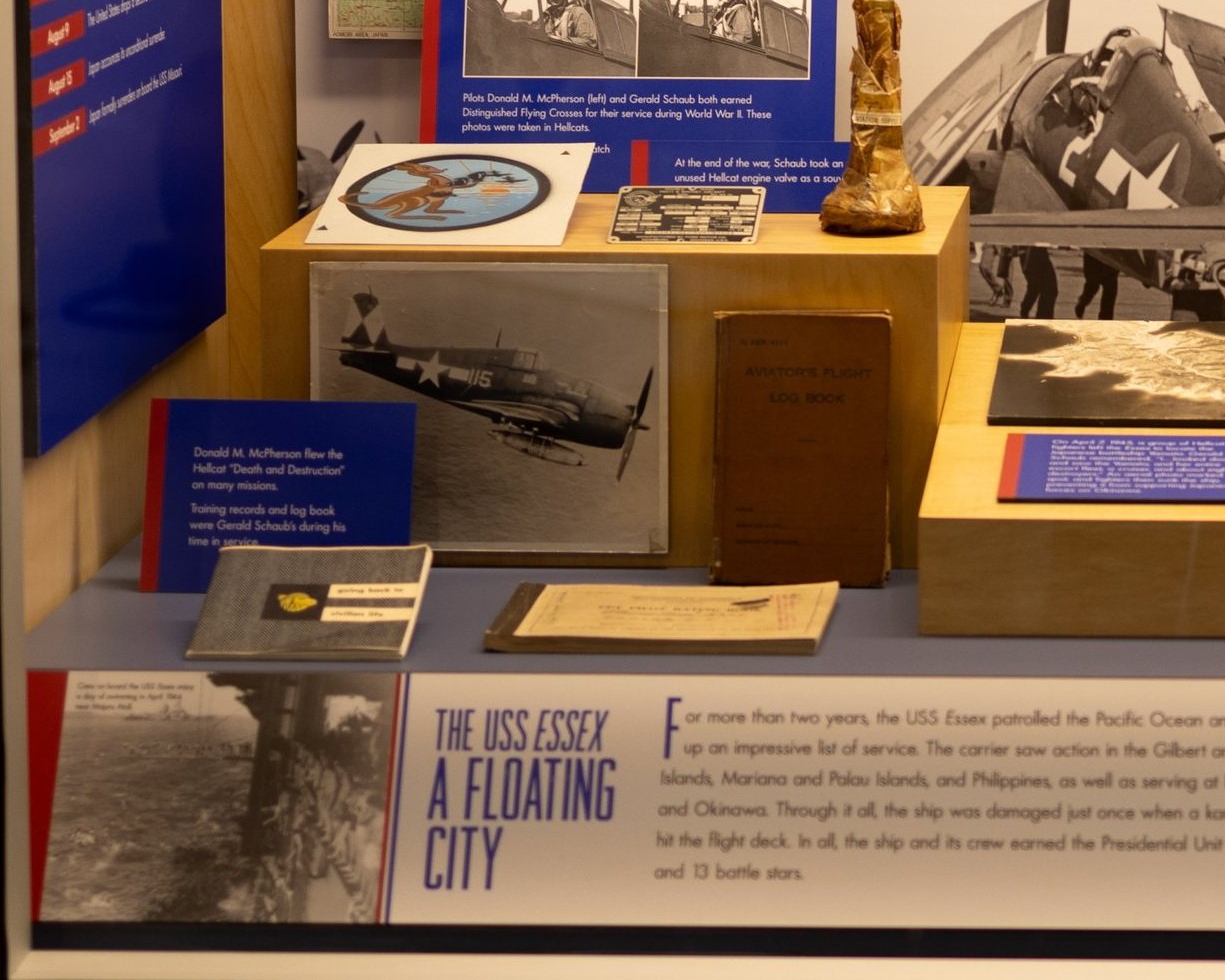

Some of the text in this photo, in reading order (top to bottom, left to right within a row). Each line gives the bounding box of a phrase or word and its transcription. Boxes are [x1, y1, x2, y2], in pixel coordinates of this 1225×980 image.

[462, 92, 752, 104] Pilots Donald M. McPherson (left) and Gerald Schaub both earned
[462, 107, 518, 119] Distinguished
[520, 107, 546, 120] Flying
[548, 107, 583, 118] Crosses
[585, 107, 597, 118] for
[600, 107, 619, 118] their
[621, 109, 652, 118] service
[654, 108, 682, 121] during
[684, 108, 712, 118] World
[714, 109, 734, 118] War
[746, 109, 771, 119] These
[461, 121, 590, 133] photos were taken in Hellcats.
[593, 143, 611, 154] atch
[674, 157, 685, 167] At
[687, 157, 701, 167] the
[703, 157, 721, 167] end
[723, 157, 733, 167] of
[735, 157, 749, 168] the
[752, 160, 770, 168] war,
[773, 157, 807, 168] Schaub
[809, 158, 829, 168] took
[674, 172, 843, 185] unused Hellcat engine valve as a souv
[823, 367, 873, 379] FLIGHT
[769, 391, 845, 404] LOG BOOK
[194, 446, 343, 460] Donald M. McPherson flew the
[192, 462, 226, 474] Hellcat
[265, 464, 284, 475] and
[207, 482, 234, 492] many
[236, 481, 278, 491] missions.
[191, 502, 335, 517] Training records and log book
[189, 522, 214, 530] were
[216, 519, 252, 530] Gerald
[298, 521, 330, 534] during
[332, 521, 346, 532] his
[211, 536, 220, 546] in
[436, 709, 608, 752] THE USS ESSEX
[426, 757, 616, 820] A FLOATING
[424, 826, 504, 889] CITY
